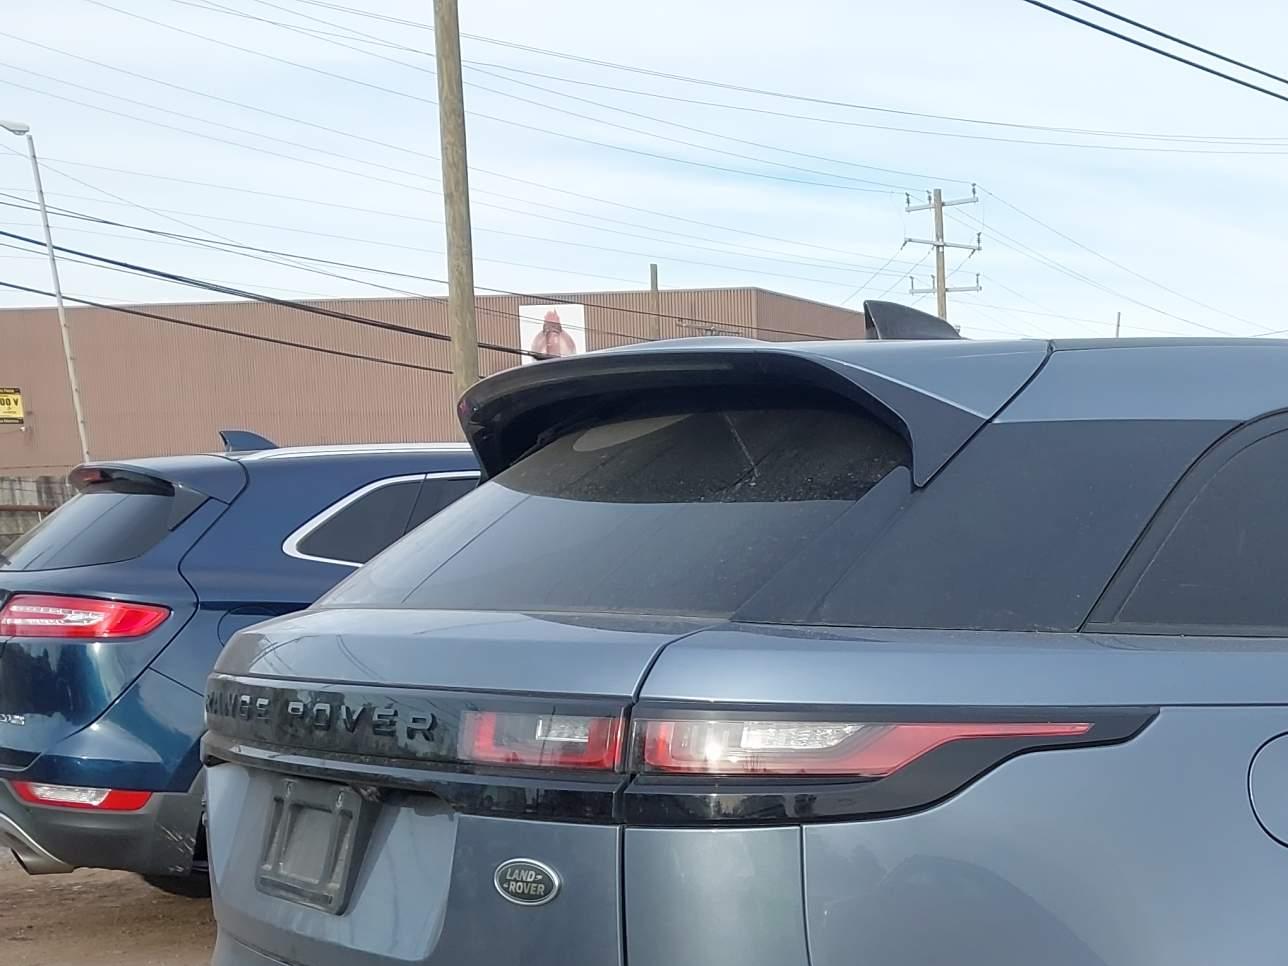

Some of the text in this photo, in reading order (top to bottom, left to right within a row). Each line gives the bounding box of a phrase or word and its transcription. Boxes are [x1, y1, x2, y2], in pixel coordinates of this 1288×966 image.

[287, 701, 438, 742] ROVER
[506, 868, 536, 882] LAND
[509, 881, 545, 896] ROVER
